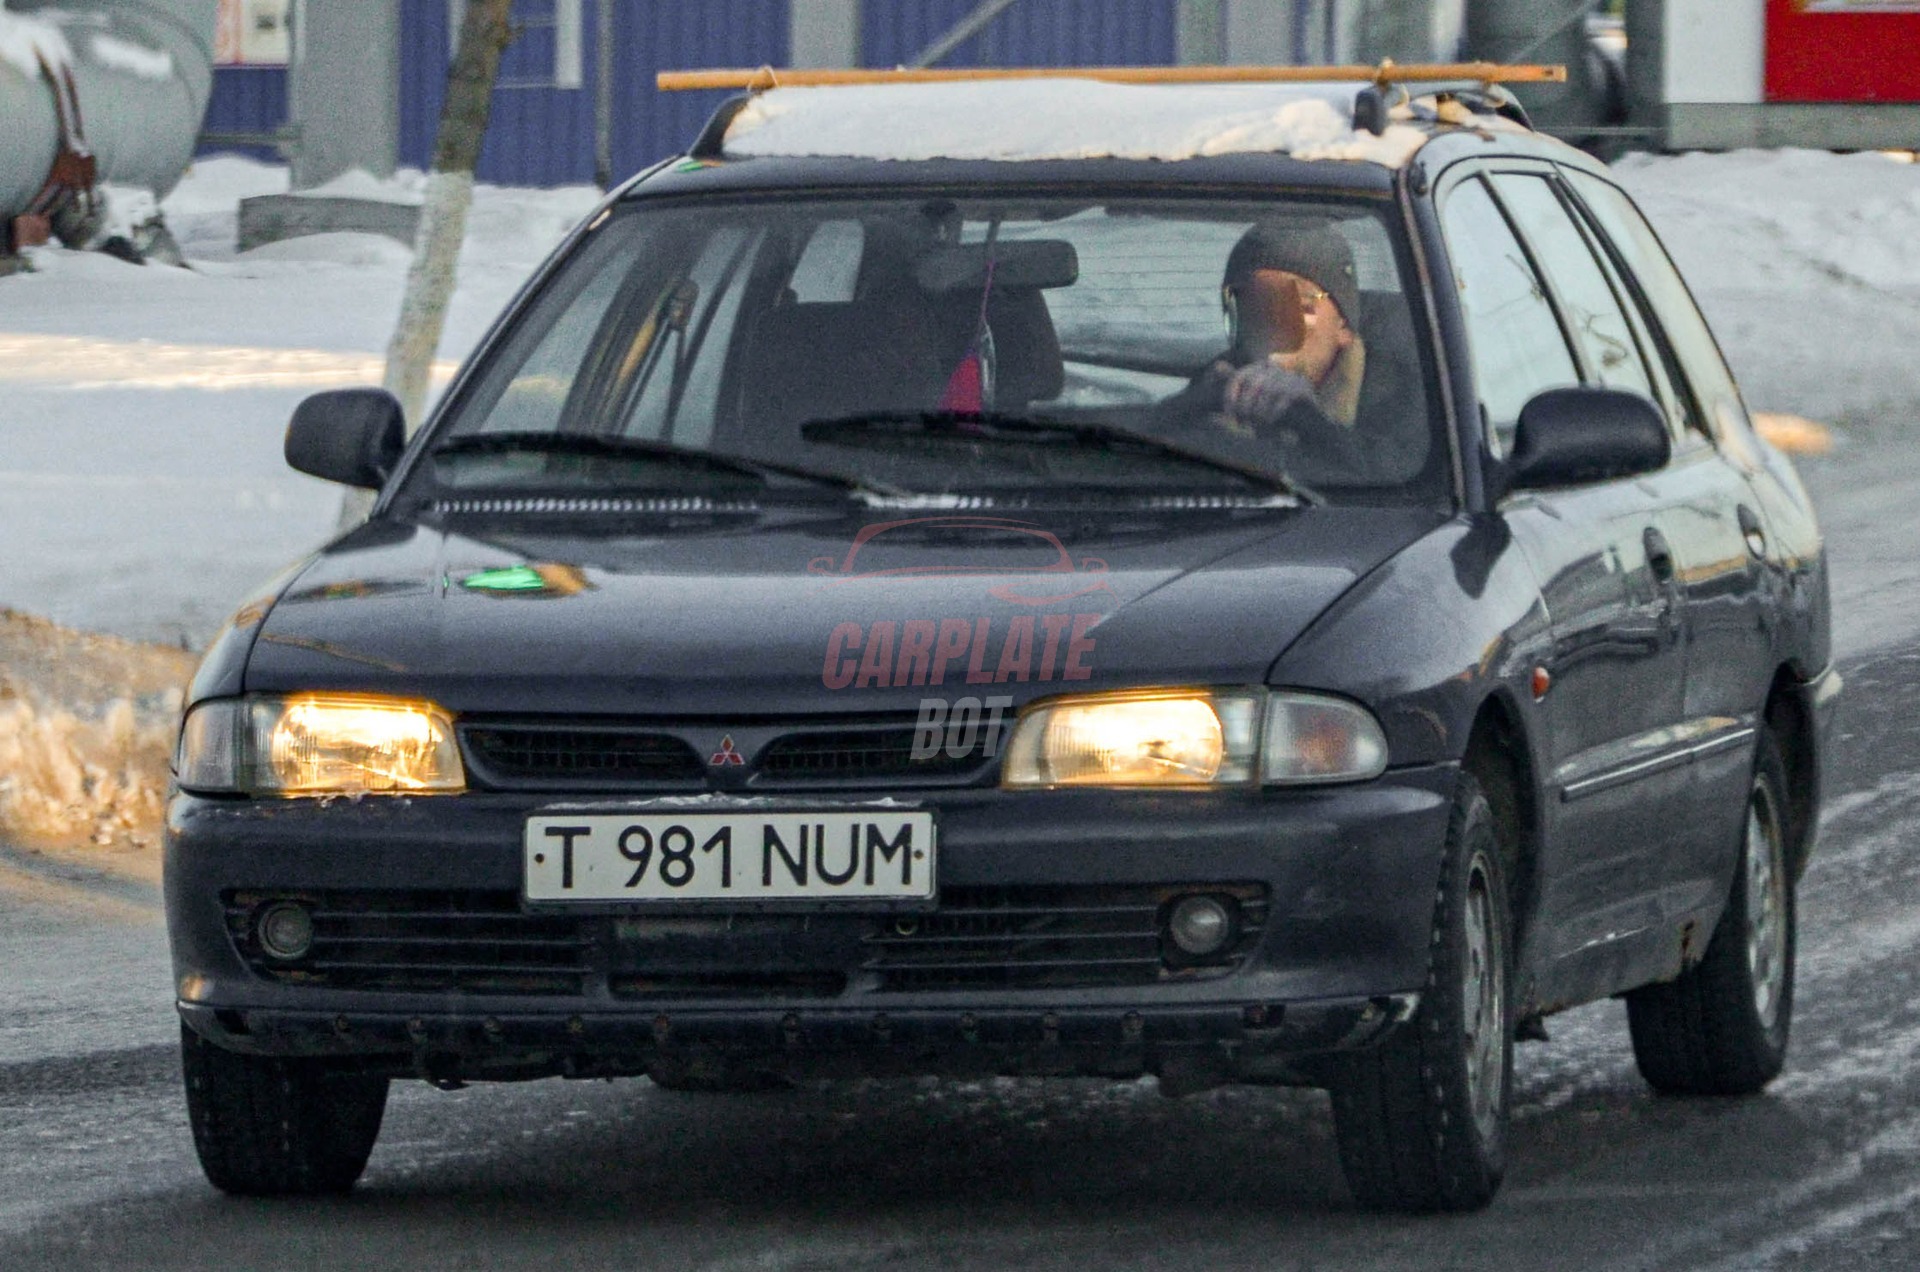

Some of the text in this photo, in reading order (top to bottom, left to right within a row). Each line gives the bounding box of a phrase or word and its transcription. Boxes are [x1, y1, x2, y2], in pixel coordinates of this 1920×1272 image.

[545, 824, 912, 888] T 981 NUM
